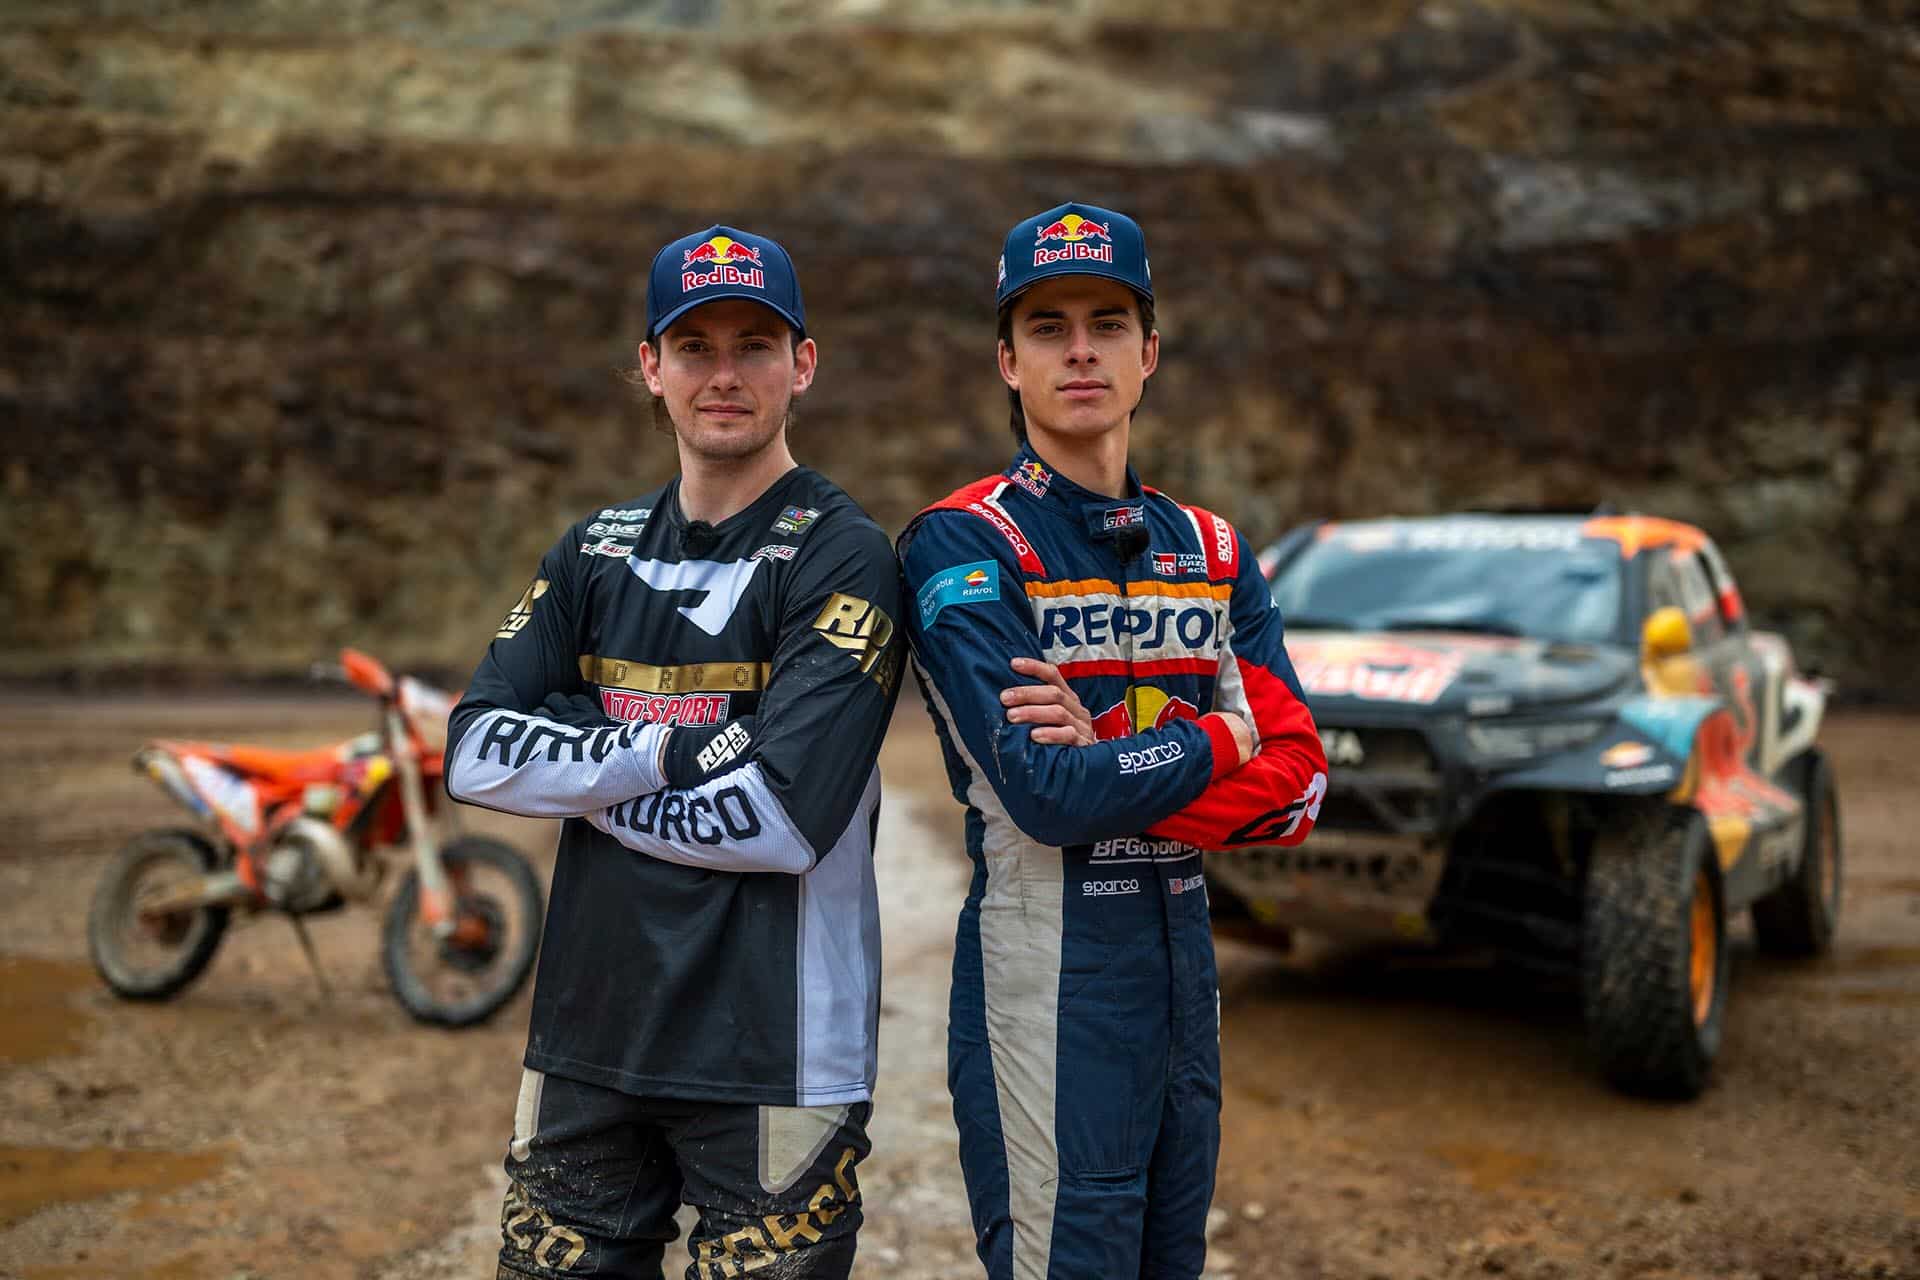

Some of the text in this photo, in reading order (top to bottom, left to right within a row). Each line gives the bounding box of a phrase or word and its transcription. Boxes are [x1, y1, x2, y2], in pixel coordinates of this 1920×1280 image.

[1033, 243, 1113, 267] Red Bull
[682, 265, 765, 293] Red Bull
[1026, 480, 1047, 499] Bull
[966, 503, 1028, 556] sparco
[962, 587, 993, 597] REPSOL
[1118, 741, 1184, 773] sparco
[1082, 879, 1139, 896] sparco
